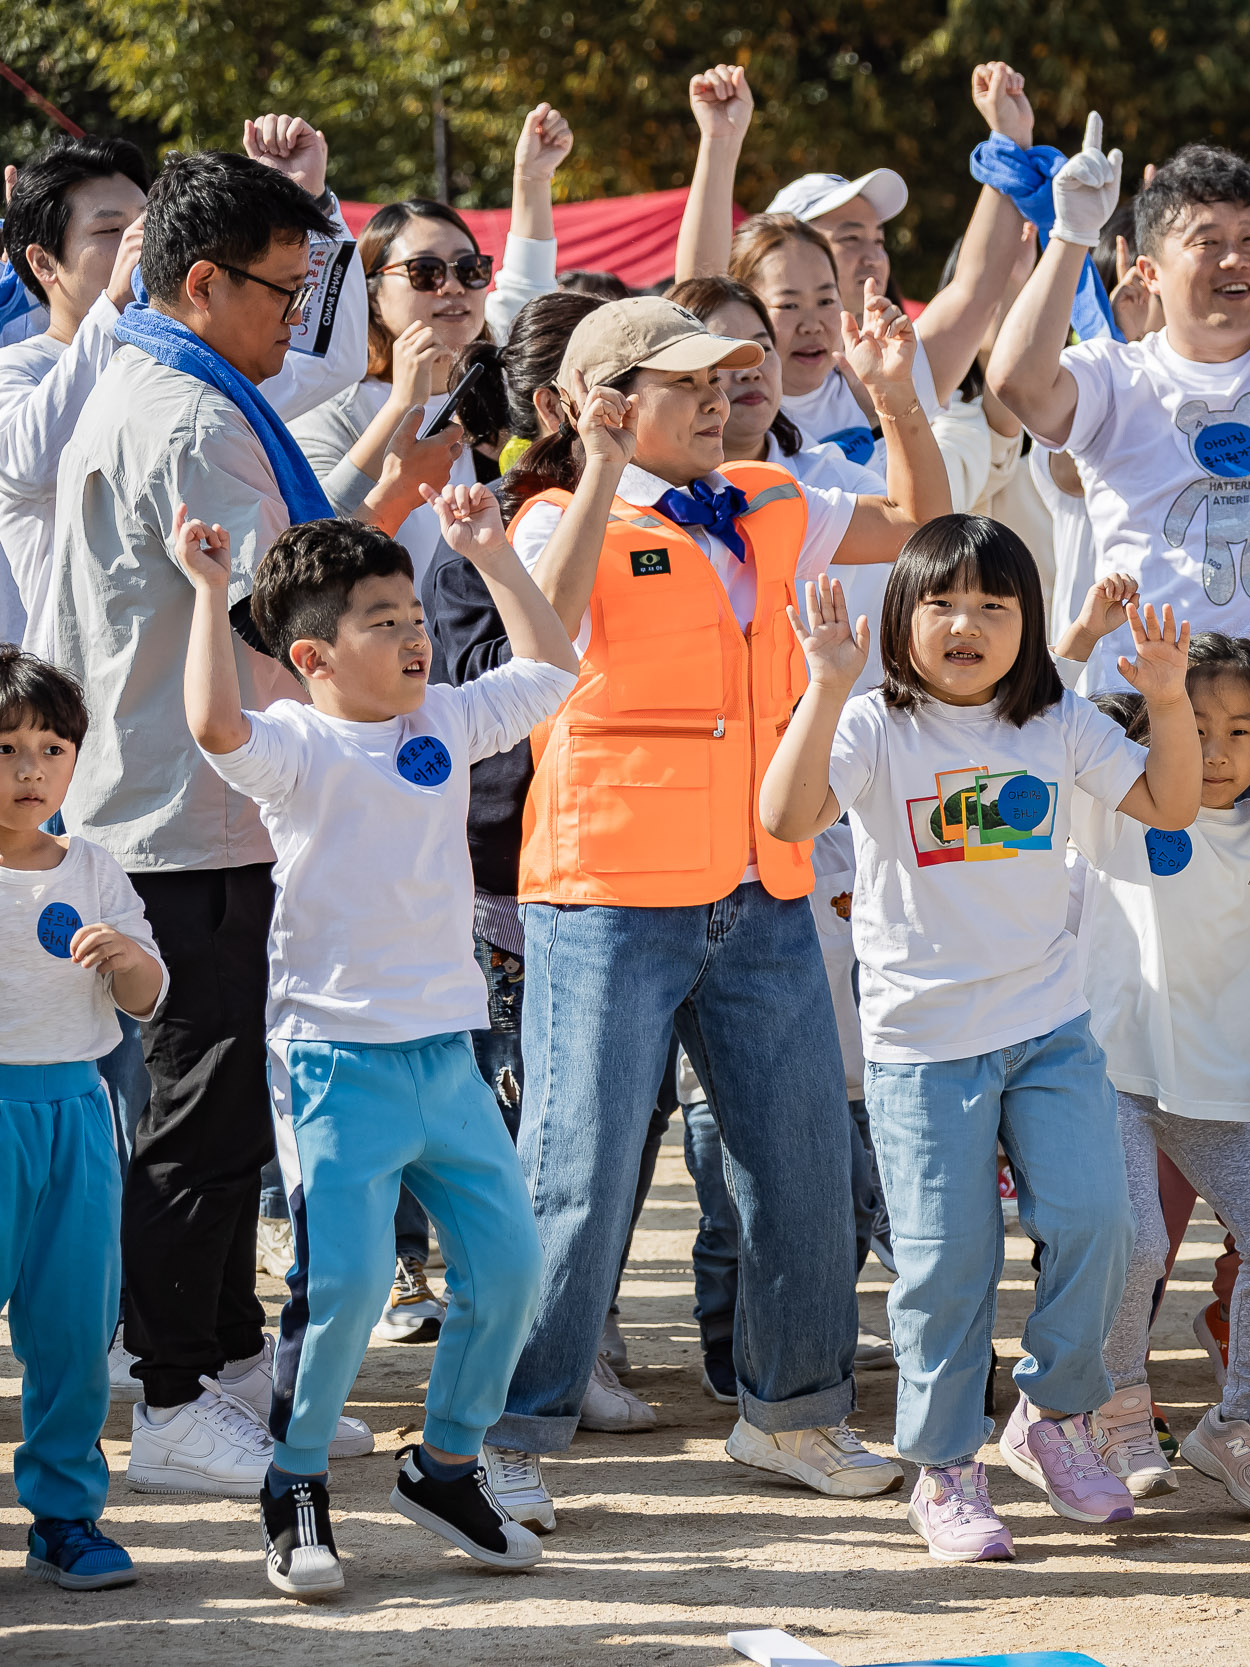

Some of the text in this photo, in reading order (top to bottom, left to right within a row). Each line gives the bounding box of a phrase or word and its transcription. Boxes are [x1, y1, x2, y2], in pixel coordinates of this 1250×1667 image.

[328, 264, 344, 295] SHARIF
[322, 296, 337, 326] OMAR
[1012, 807, 1038, 820] 하나
[42, 907, 78, 931] 푸르내
[41, 928, 71, 953] 한시
[296, 1500, 314, 1508] adidas
